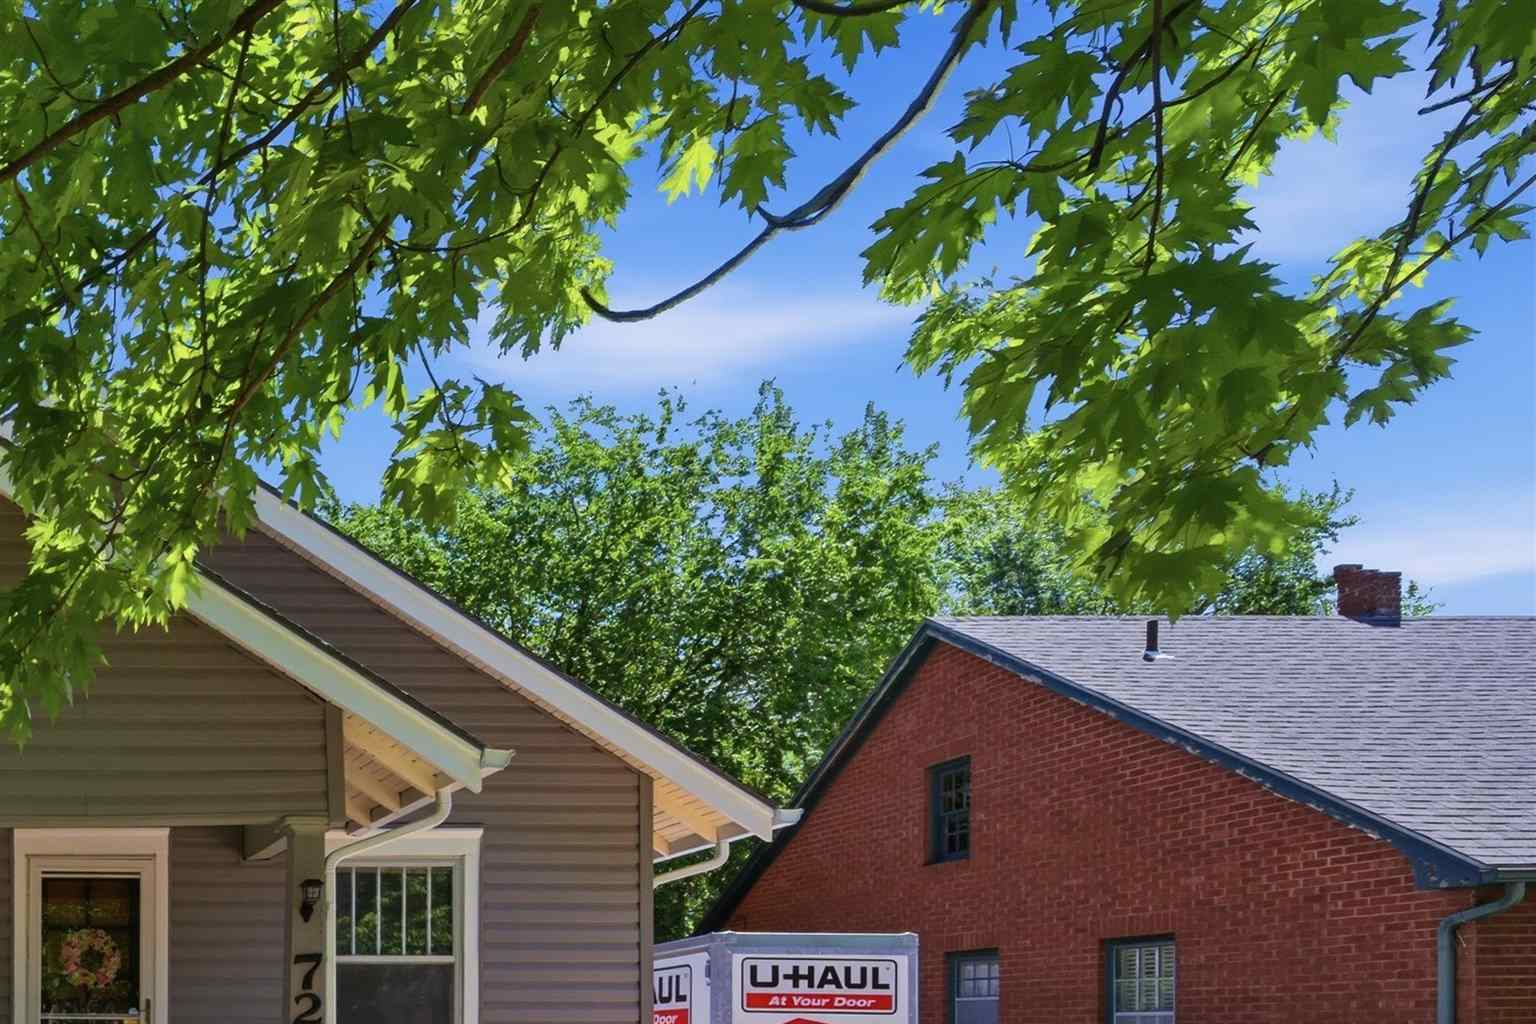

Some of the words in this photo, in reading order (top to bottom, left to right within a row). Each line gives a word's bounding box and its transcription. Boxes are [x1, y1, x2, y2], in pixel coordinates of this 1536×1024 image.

[750, 964, 890, 990] U-HAUL
[768, 996, 786, 1006] At
[792, 996, 830, 1007] Your
[833, 997, 876, 1008] Door
